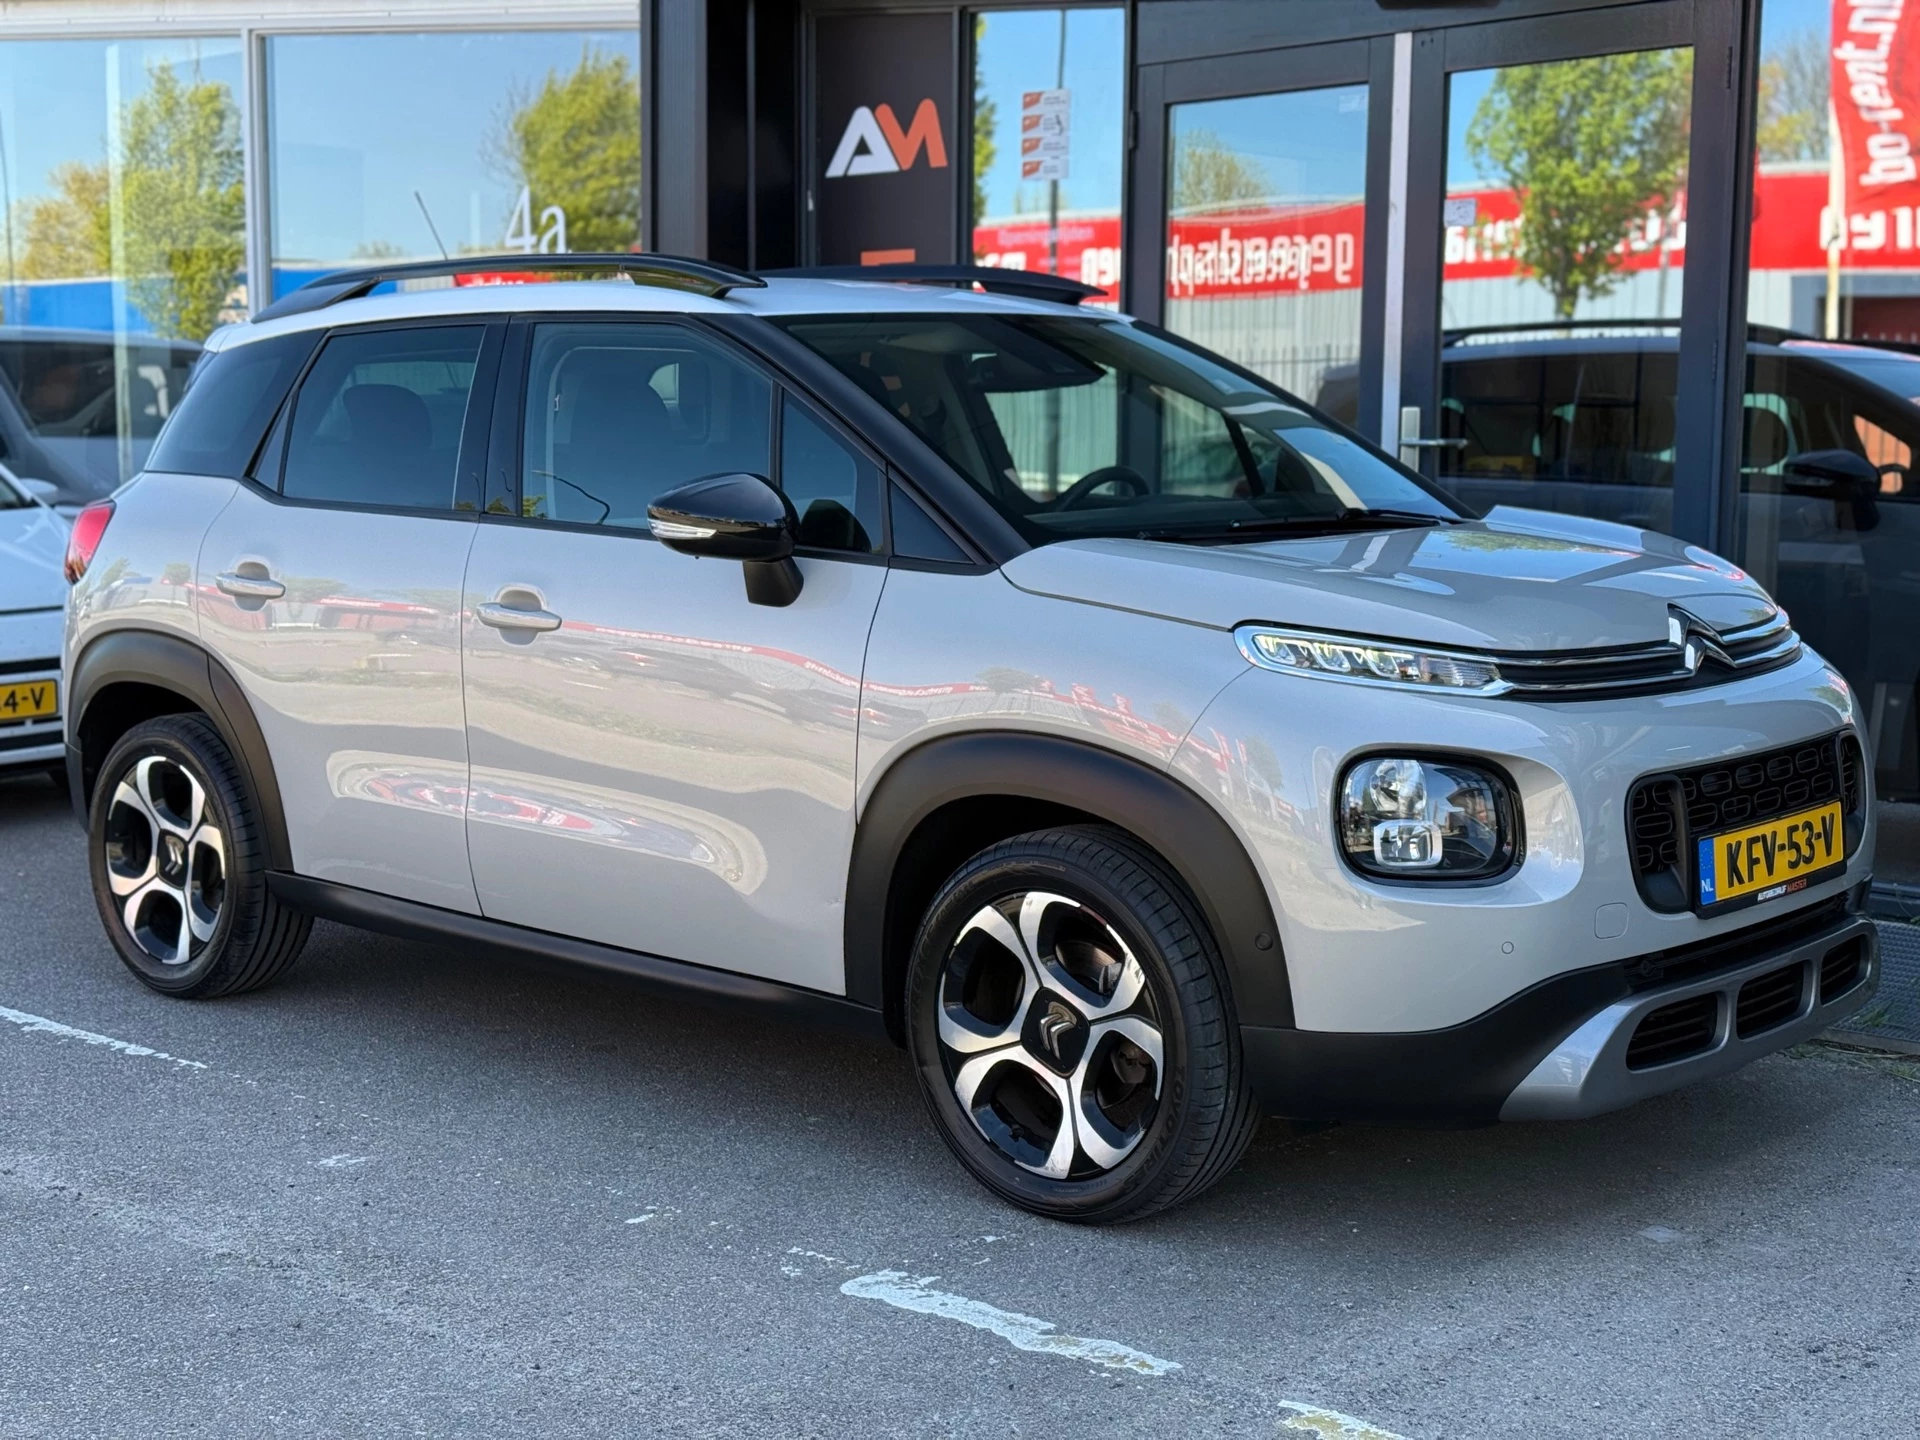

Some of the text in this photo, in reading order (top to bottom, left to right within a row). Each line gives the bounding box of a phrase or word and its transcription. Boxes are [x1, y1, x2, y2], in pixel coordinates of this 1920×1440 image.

[825, 97, 949, 179] AM
[504, 186, 567, 255] 4a
[0, 686, 46, 714] 4-V
[1726, 812, 1835, 889] KFV-53-V
[1701, 879, 1714, 894] NL
